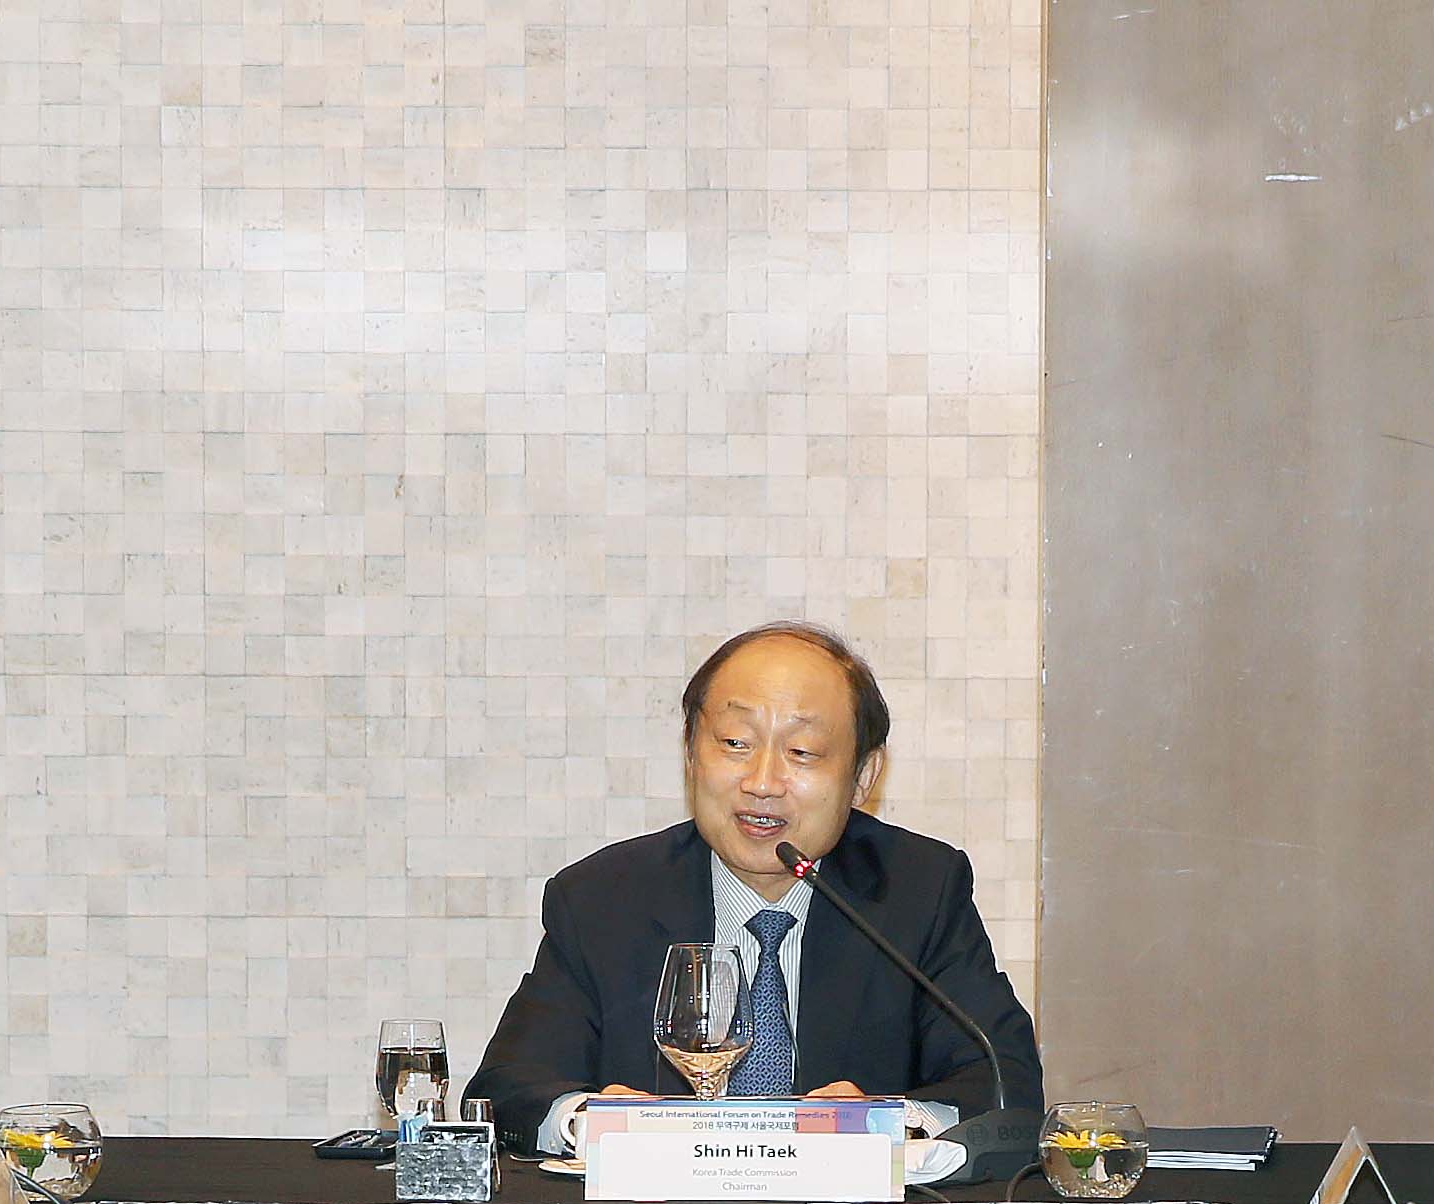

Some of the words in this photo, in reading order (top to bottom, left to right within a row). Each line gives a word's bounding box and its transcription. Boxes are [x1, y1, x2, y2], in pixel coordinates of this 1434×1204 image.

[639, 1110, 663, 1118] Seoul
[665, 1110, 721, 1118] International
[723, 1110, 749, 1118] Forum
[763, 1111, 787, 1119] Trade
[692, 1121, 714, 1130] 2018
[716, 1121, 749, 1130] 무역구제
[693, 1144, 731, 1157] Shin
[736, 1144, 754, 1157] Hi
[757, 1144, 797, 1157] Taek
[692, 1168, 717, 1177] Korea
[718, 1168, 743, 1177] Trade
[744, 1168, 798, 1177] Commission
[722, 1181, 767, 1191] Chairman
